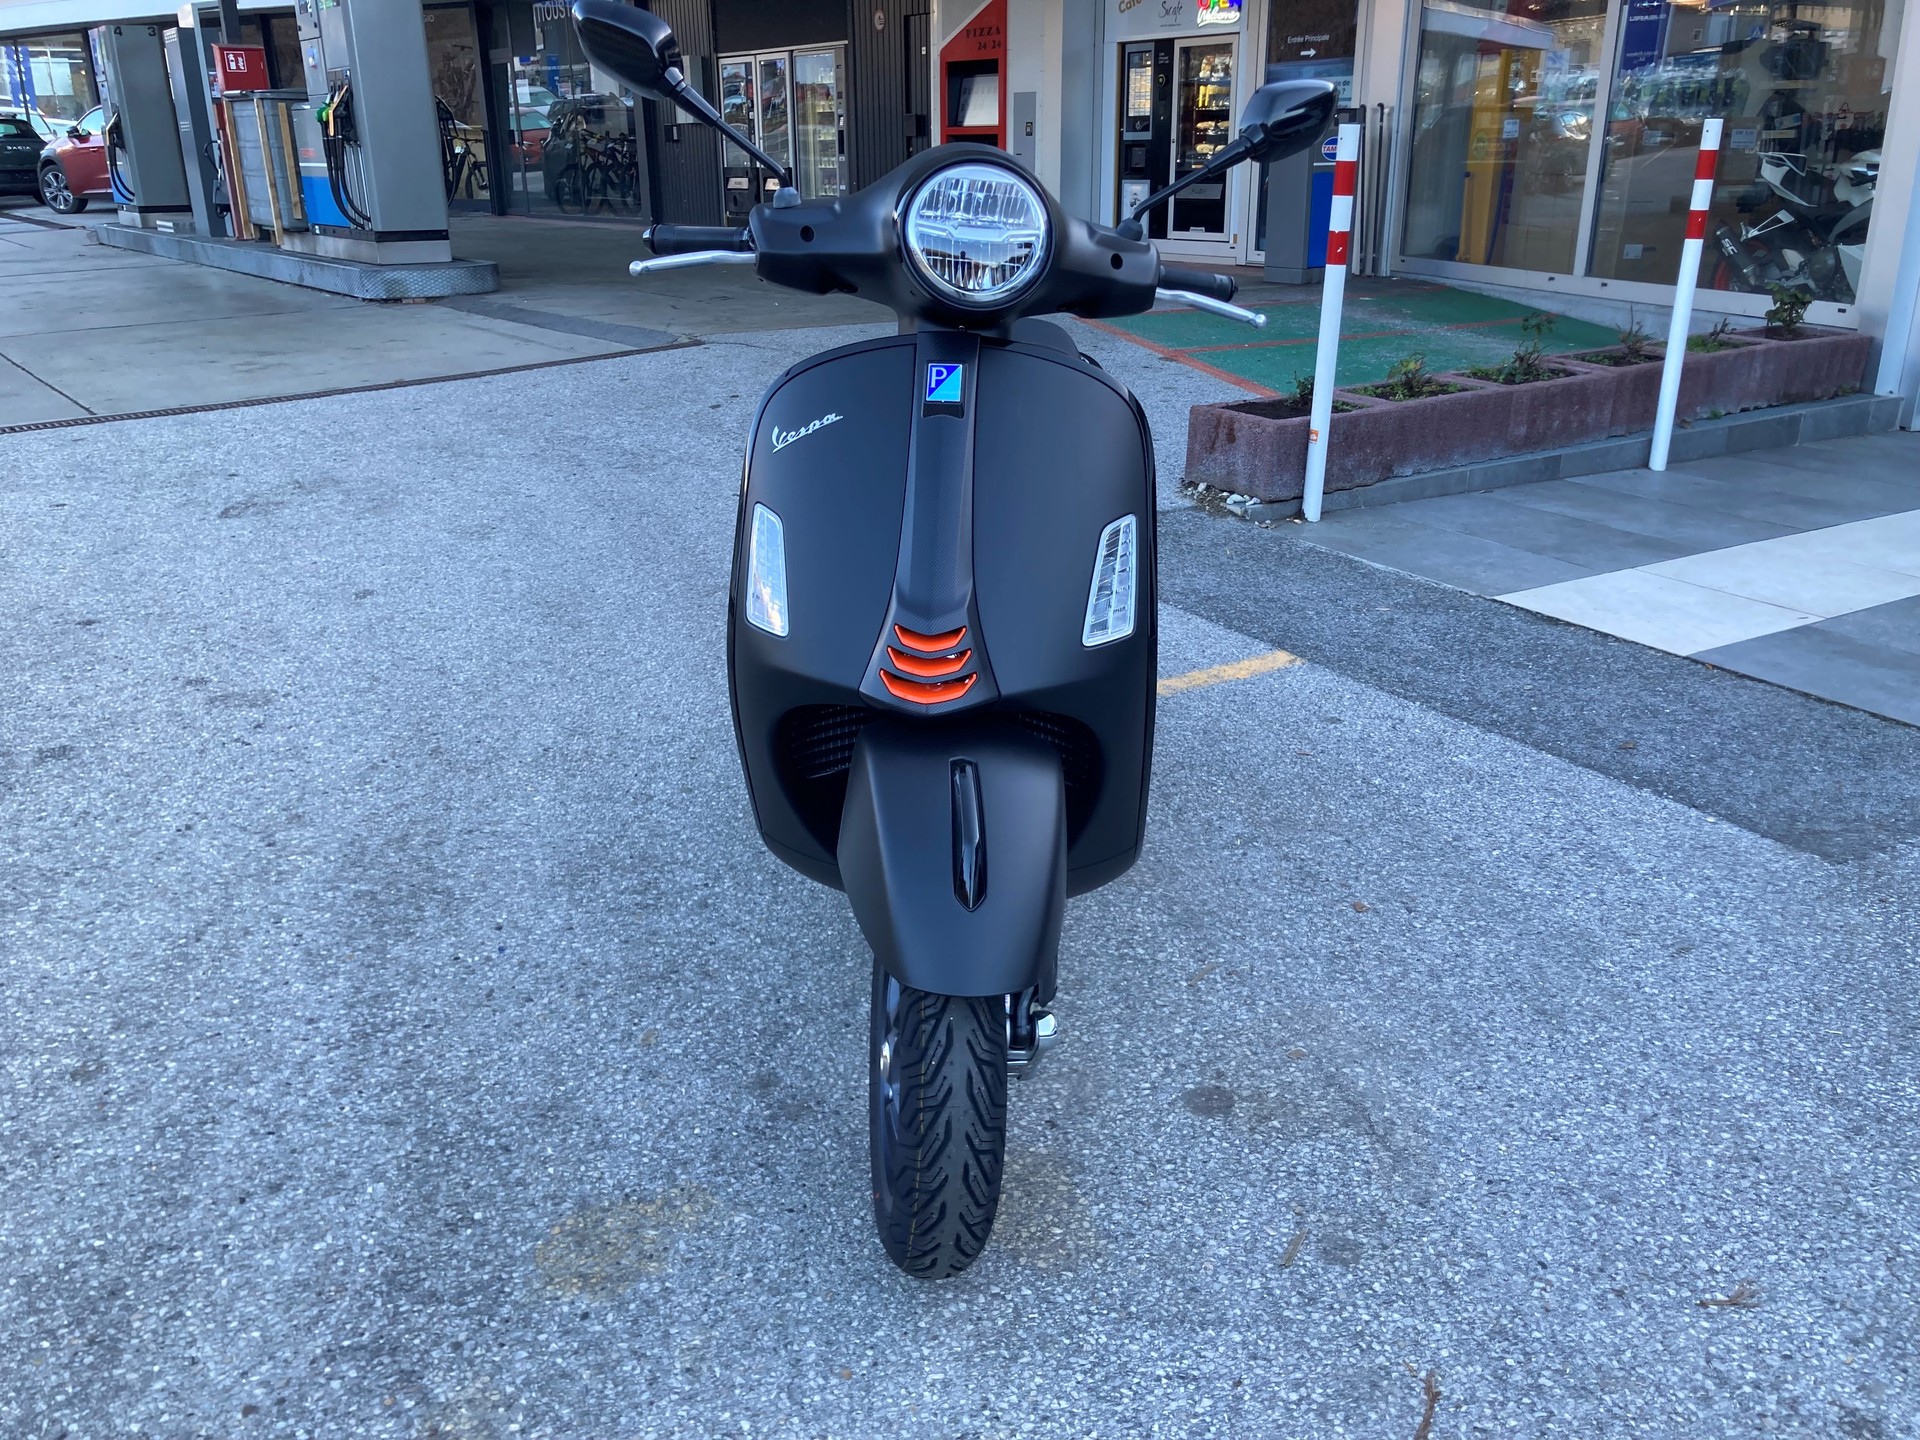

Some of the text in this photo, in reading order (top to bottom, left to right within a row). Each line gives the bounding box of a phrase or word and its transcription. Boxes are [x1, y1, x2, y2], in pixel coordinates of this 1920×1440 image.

[1197, 6, 1240, 27] Welcome
[113, 26, 123, 36] 4
[148, 26, 157, 36] 3
[966, 26, 1001, 38] PIZZA
[1305, 34, 1330, 42] Principale
[930, 366, 948, 388] P
[771, 412, 844, 453] Vespa
